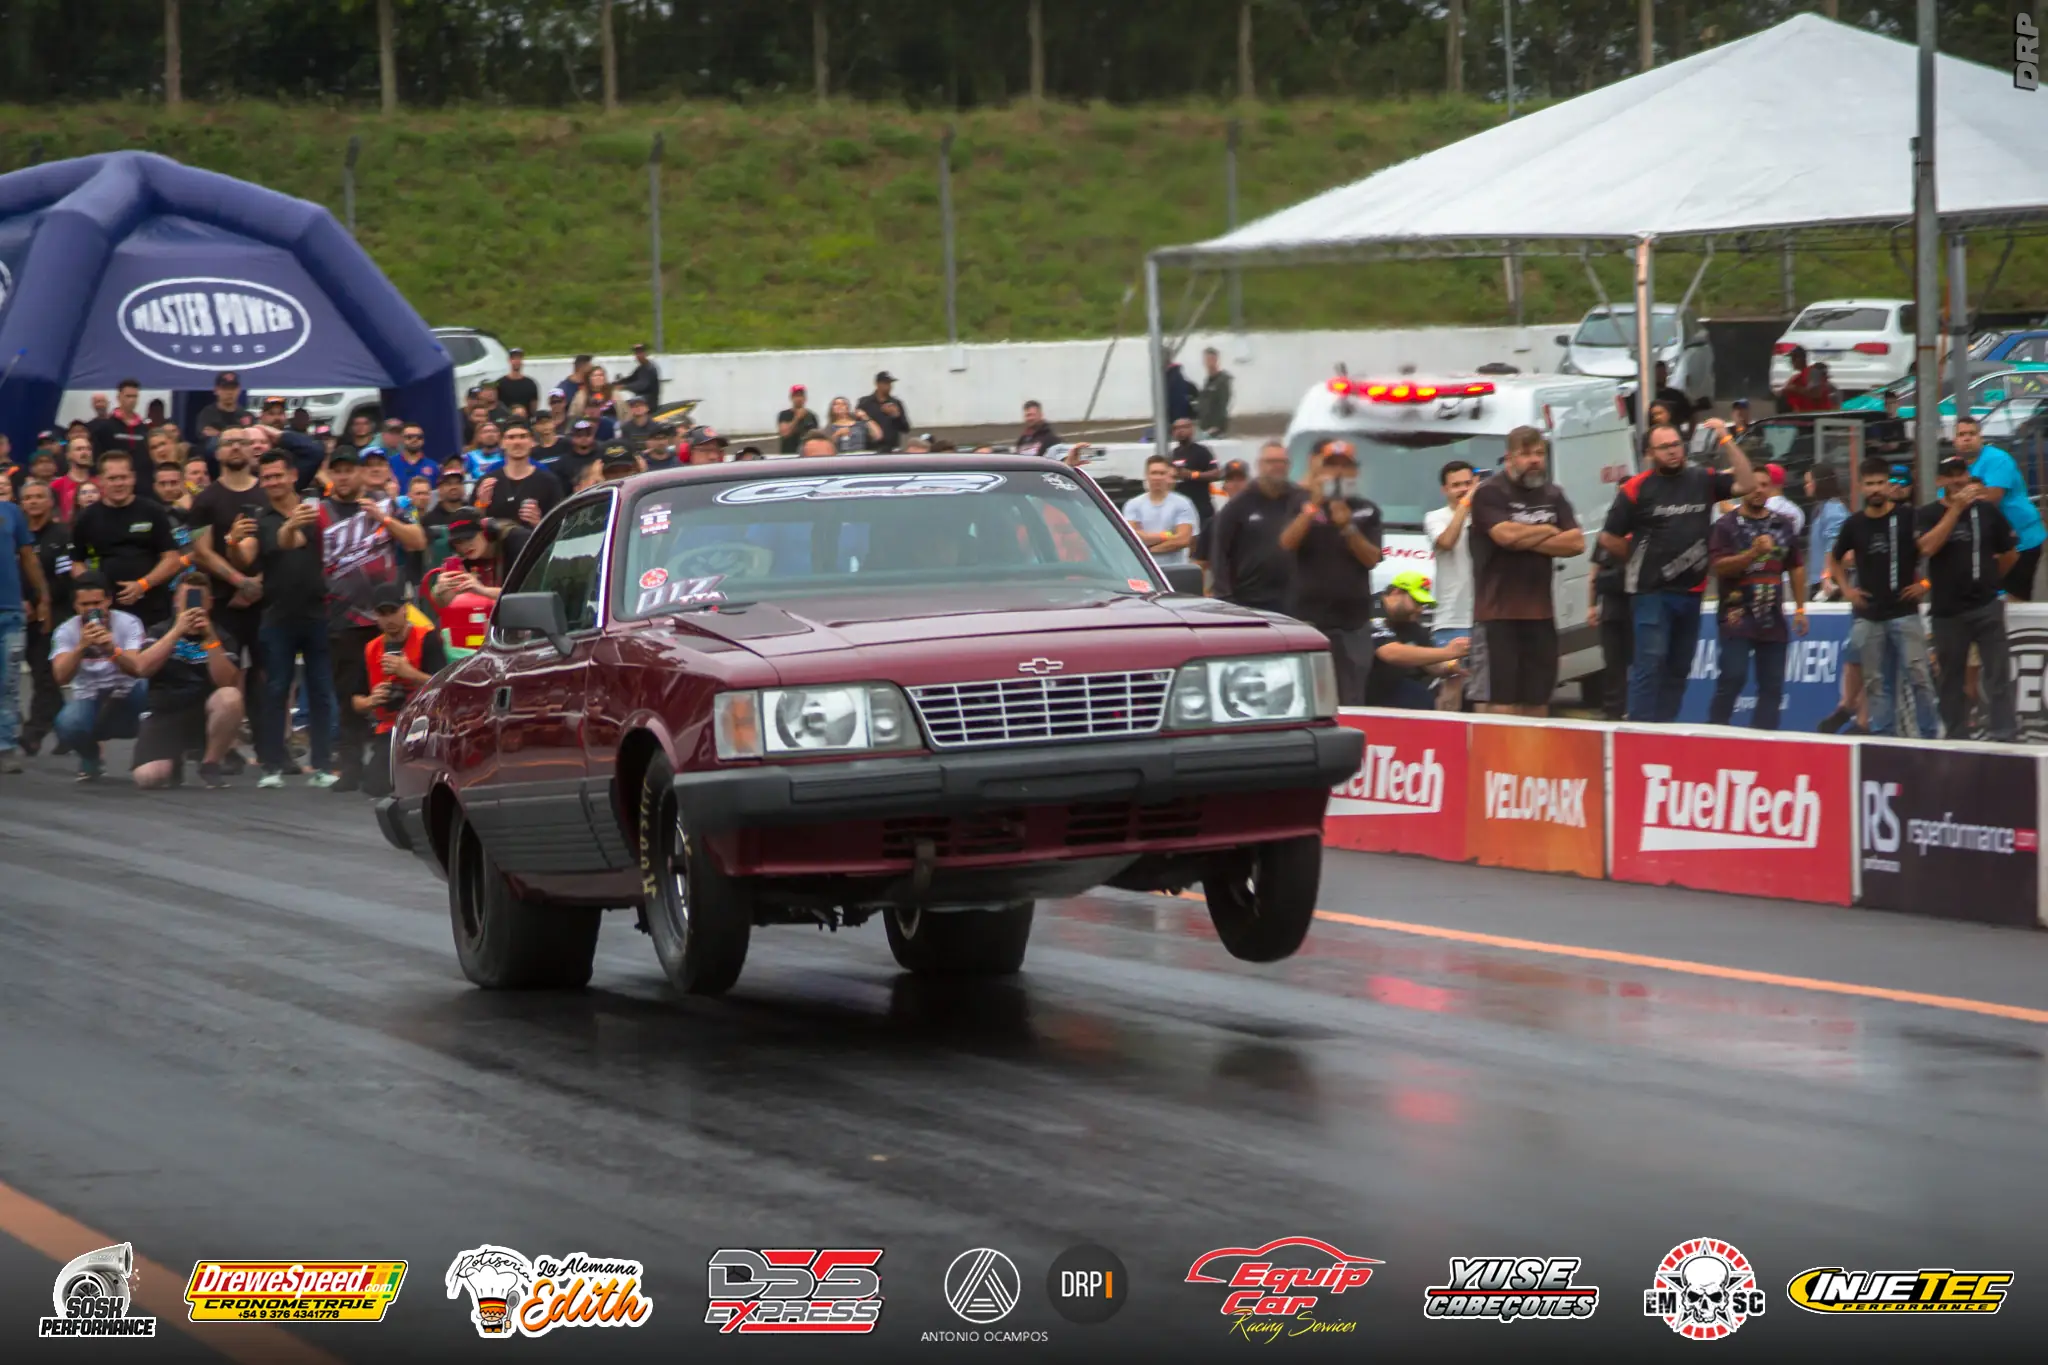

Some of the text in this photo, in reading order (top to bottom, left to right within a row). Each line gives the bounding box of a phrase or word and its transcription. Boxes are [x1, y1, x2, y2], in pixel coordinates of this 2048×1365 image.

[132, 292, 295, 337] MASTER POWER
[1484, 770, 1588, 828] VELOPARK
[1640, 763, 1822, 852] FuelTech
